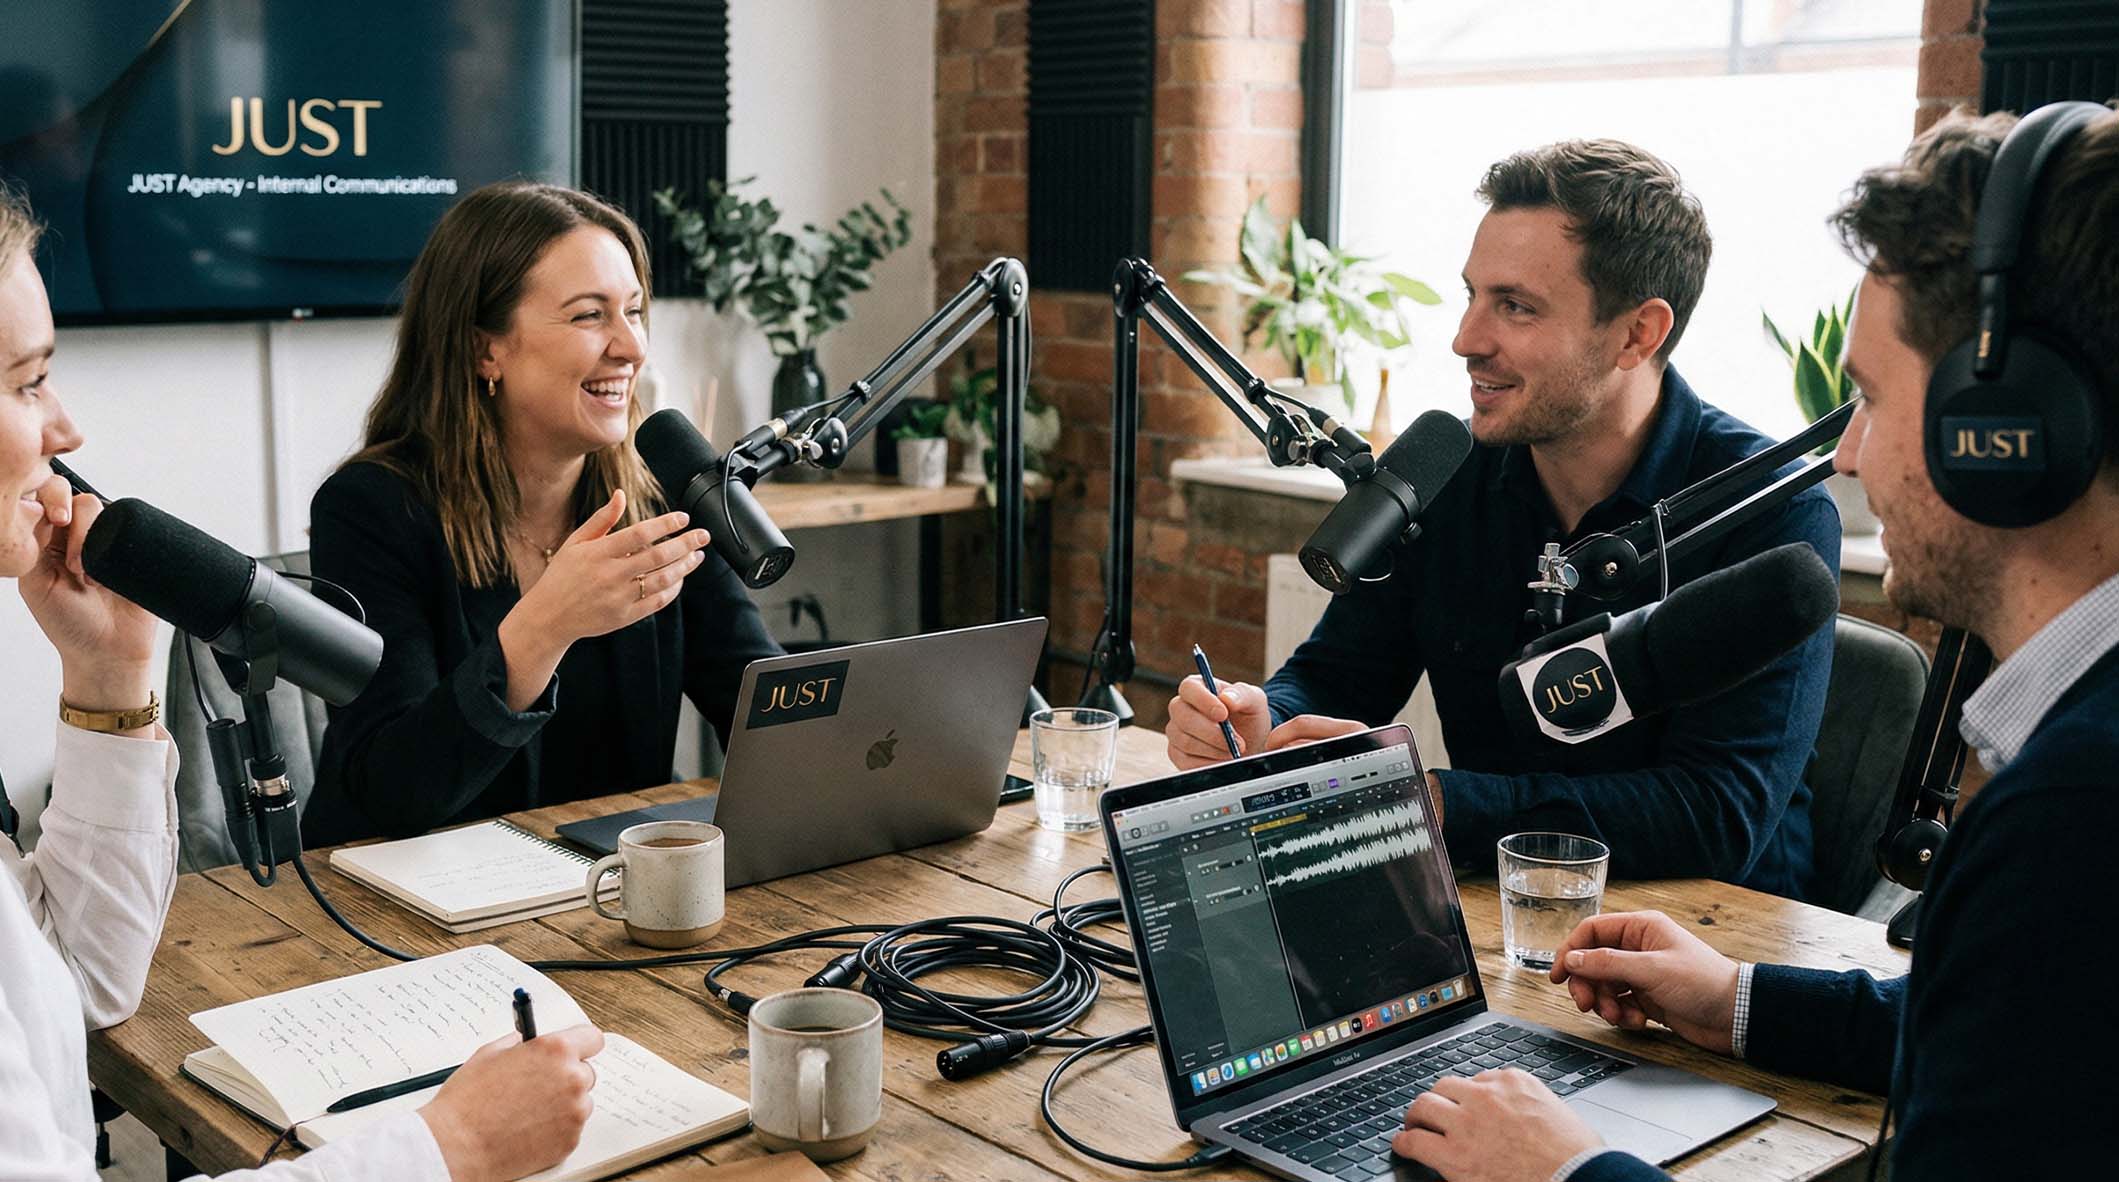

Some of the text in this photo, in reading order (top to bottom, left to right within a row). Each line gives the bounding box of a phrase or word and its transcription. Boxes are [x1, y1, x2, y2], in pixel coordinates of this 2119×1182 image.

[211, 95, 383, 158] JUST
[127, 173, 458, 197] JUST Agency - Internal Communications
[1951, 429, 2035, 458] JUST
[760, 677, 837, 713] JUST
[1546, 665, 1604, 714] JUST
